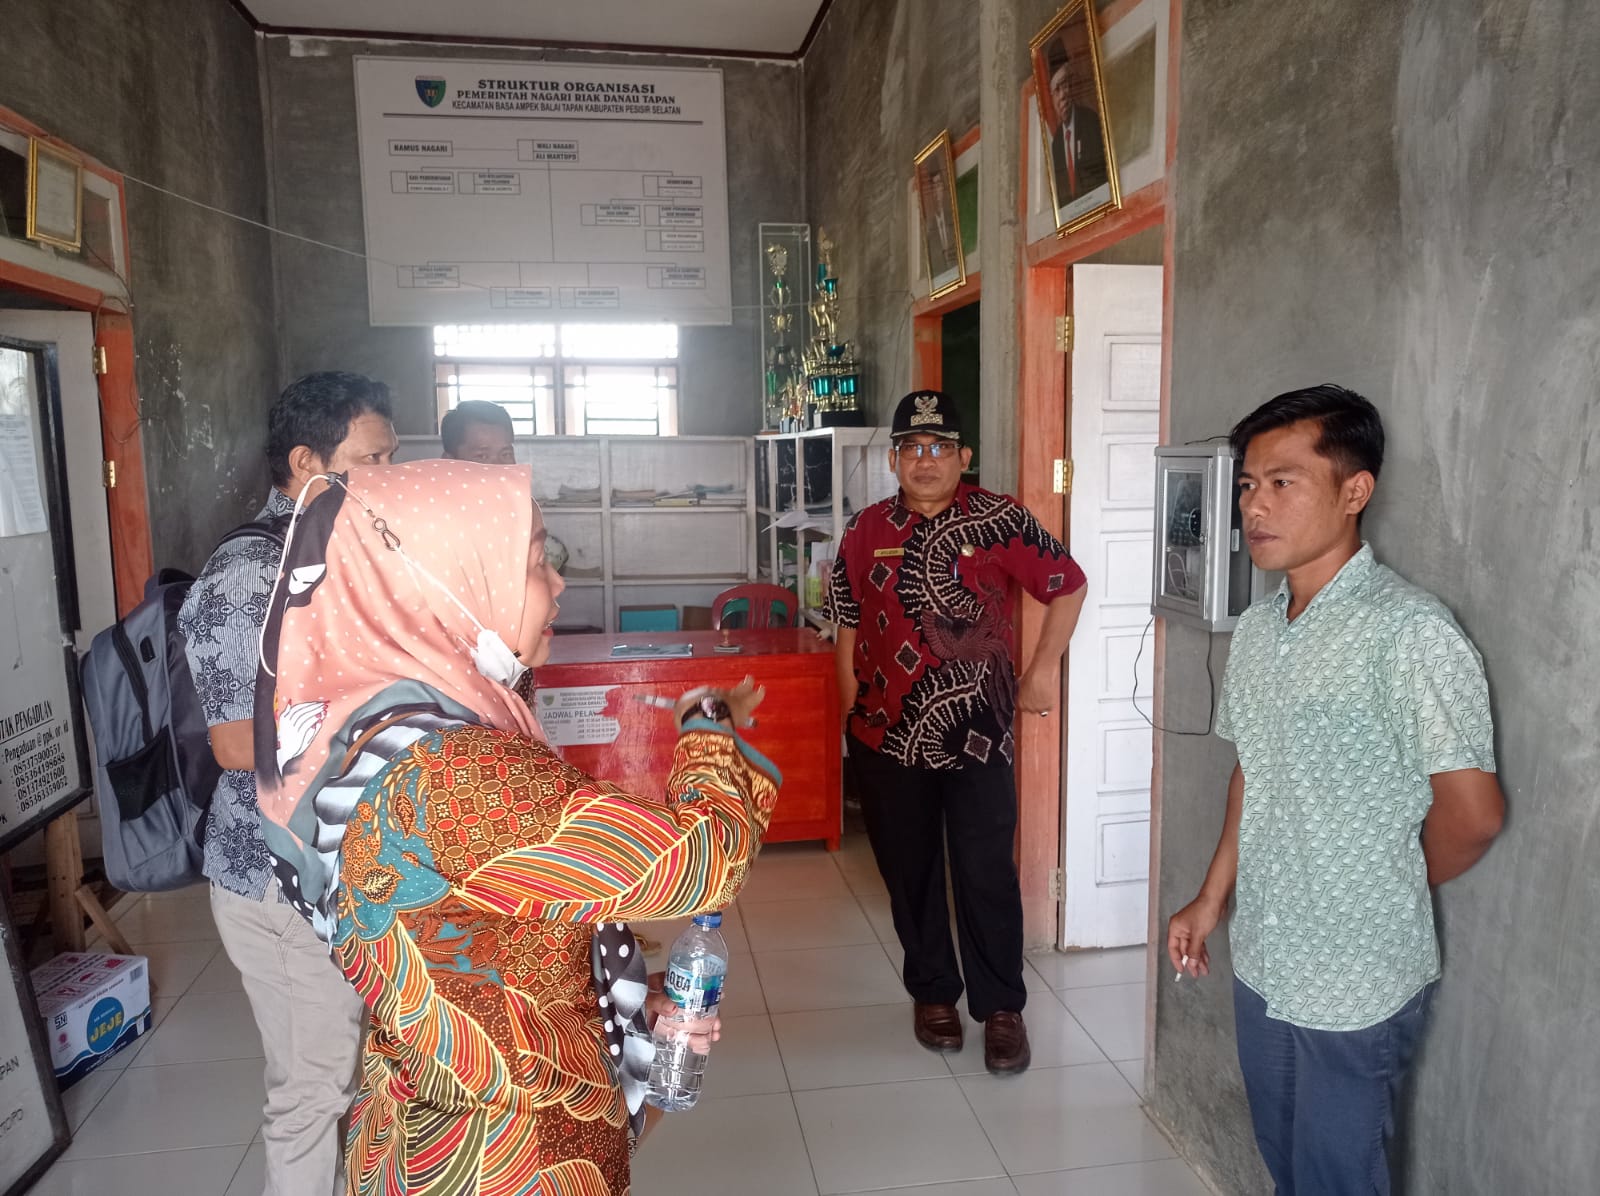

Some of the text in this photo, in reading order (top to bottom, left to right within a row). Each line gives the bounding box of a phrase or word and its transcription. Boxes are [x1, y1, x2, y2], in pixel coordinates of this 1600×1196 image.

[478, 79, 655, 94] STRUKTUR ORGANISASI
[457, 90, 675, 104] PEMERINTAH NAGARI RIAK DANAU TAPAN
[452, 100, 681, 115] KECAMATAN BASA AMPEK BALAI TAPAN KABUPATEN PESISIR SELATAN
[0, 700, 53, 739] TAK PENGADUAN
[544, 711, 573, 719] JADWAL
[90, 1012, 122, 1043] JEJE
